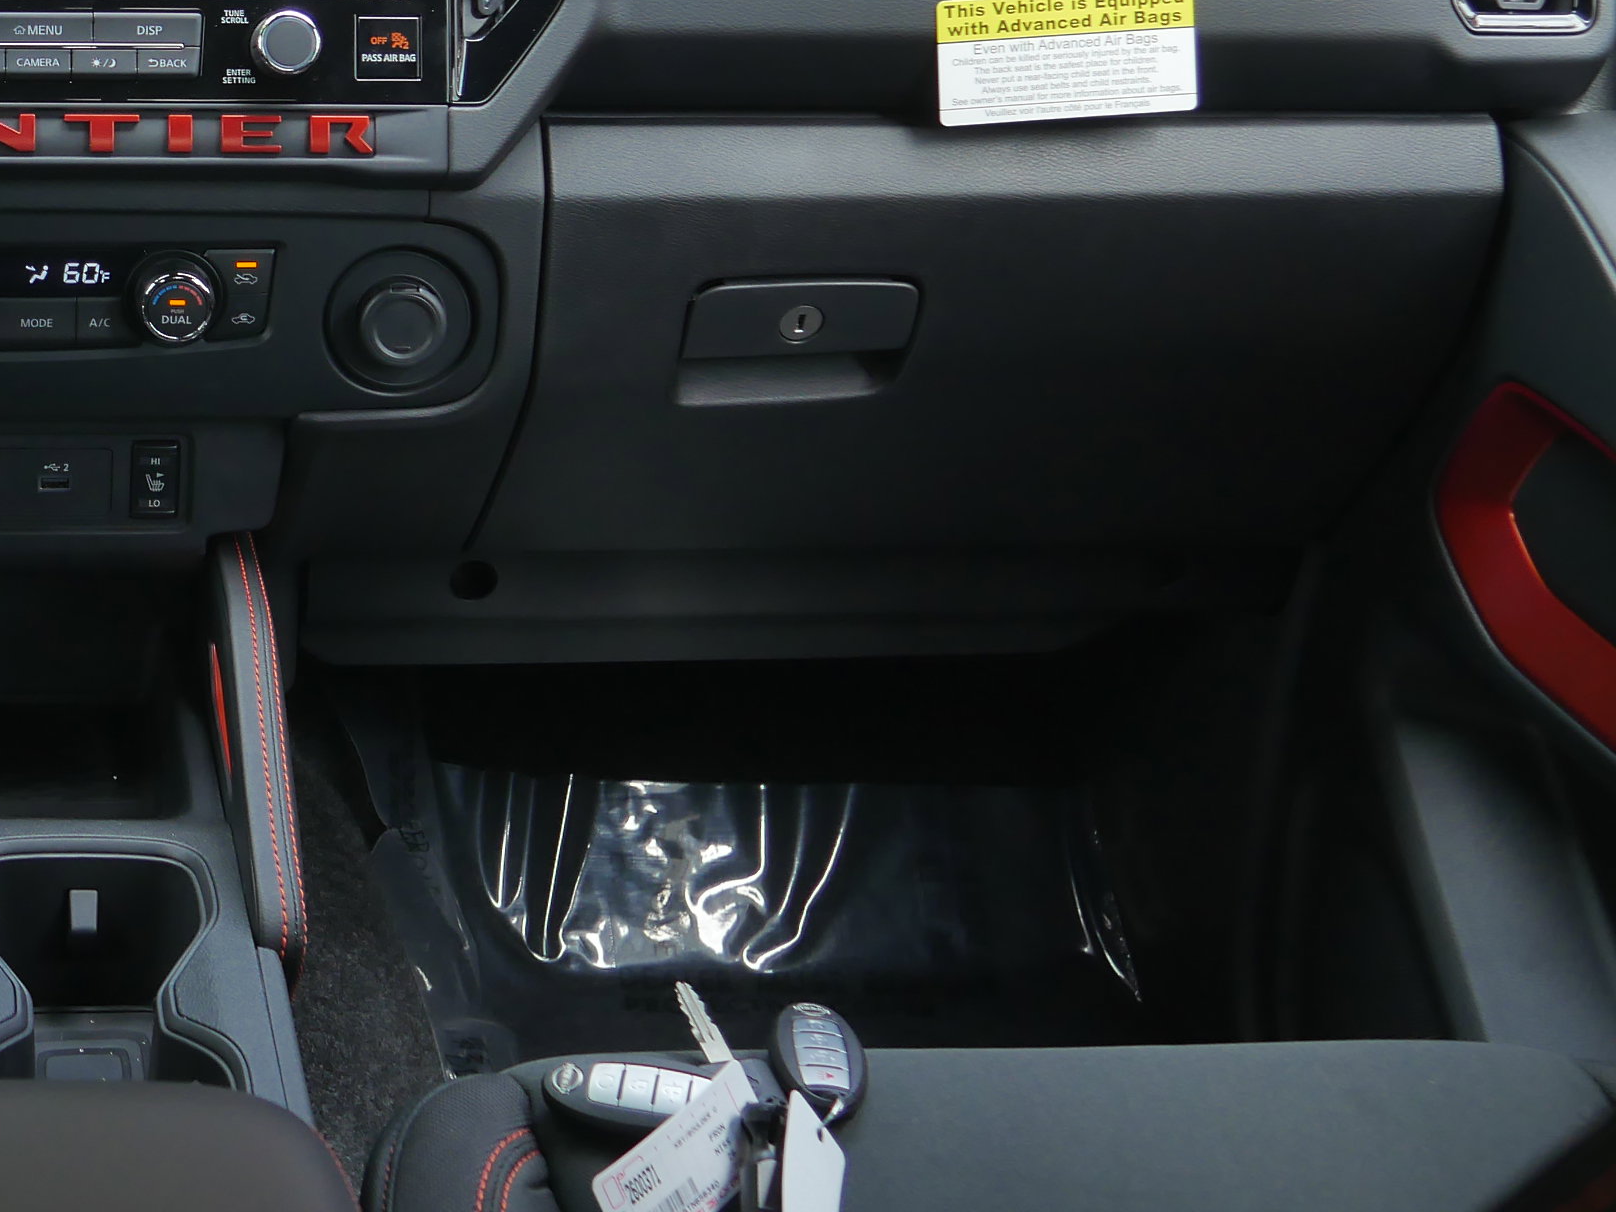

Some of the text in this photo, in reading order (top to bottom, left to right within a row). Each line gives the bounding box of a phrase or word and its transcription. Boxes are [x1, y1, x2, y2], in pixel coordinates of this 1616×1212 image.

[944, 4, 985, 19] This
[221, 16, 249, 24] SCROLL
[948, 9, 1182, 37] with Advanced Air Bags
[27, 24, 63, 36] MENU
[136, 24, 163, 36] DISP
[370, 36, 387, 45] OFF
[973, 33, 1158, 55] Even with Advanced Air Bags
[16, 57, 60, 67] CAMERA
[159, 58, 187, 68] BACK
[361, 53, 416, 63] PASS AIR BAG
[222, 76, 256, 84] SETTING
[20, 318, 53, 328] MODE
[89, 318, 110, 327] A/C
[161, 315, 192, 325] DUAL
[150, 457, 161, 465] HI
[63, 463, 69, 471] 2
[148, 499, 161, 507] LO
